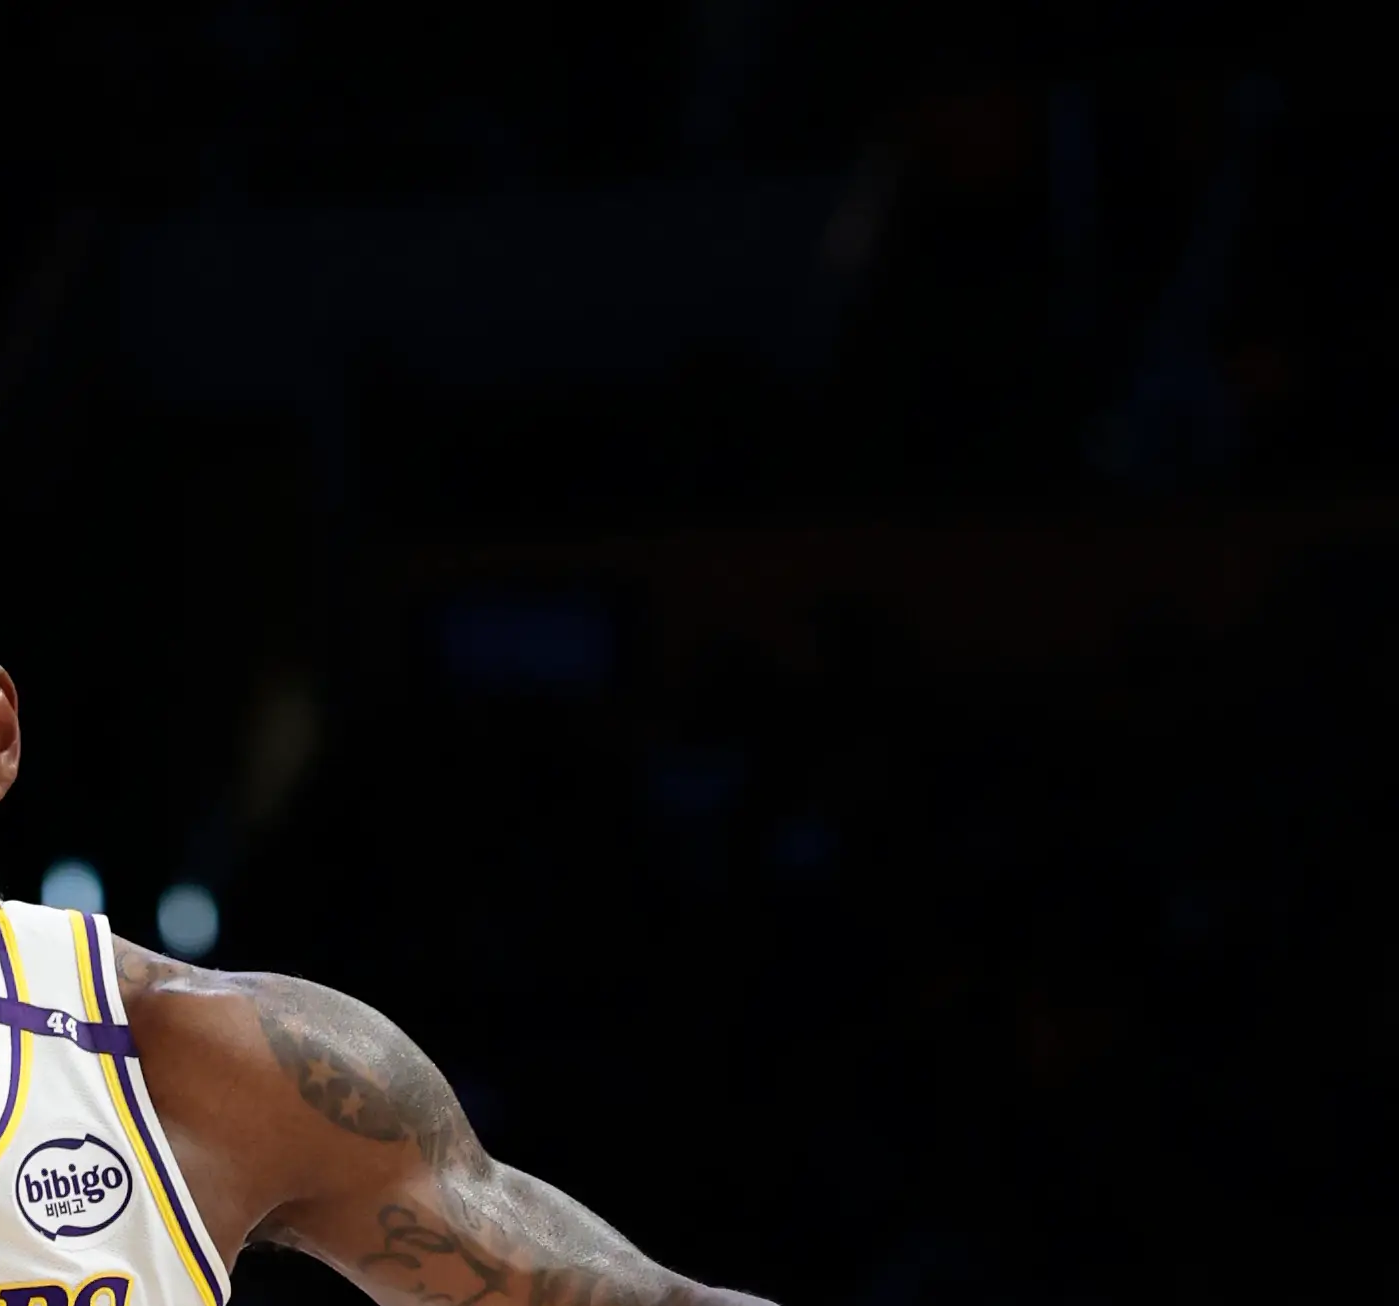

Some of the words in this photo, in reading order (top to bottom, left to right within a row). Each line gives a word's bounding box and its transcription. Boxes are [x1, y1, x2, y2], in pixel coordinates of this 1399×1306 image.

[47, 1011, 78, 1042] 44
[24, 1163, 123, 1204] bibigo
[45, 1199, 87, 1218] 비비고
